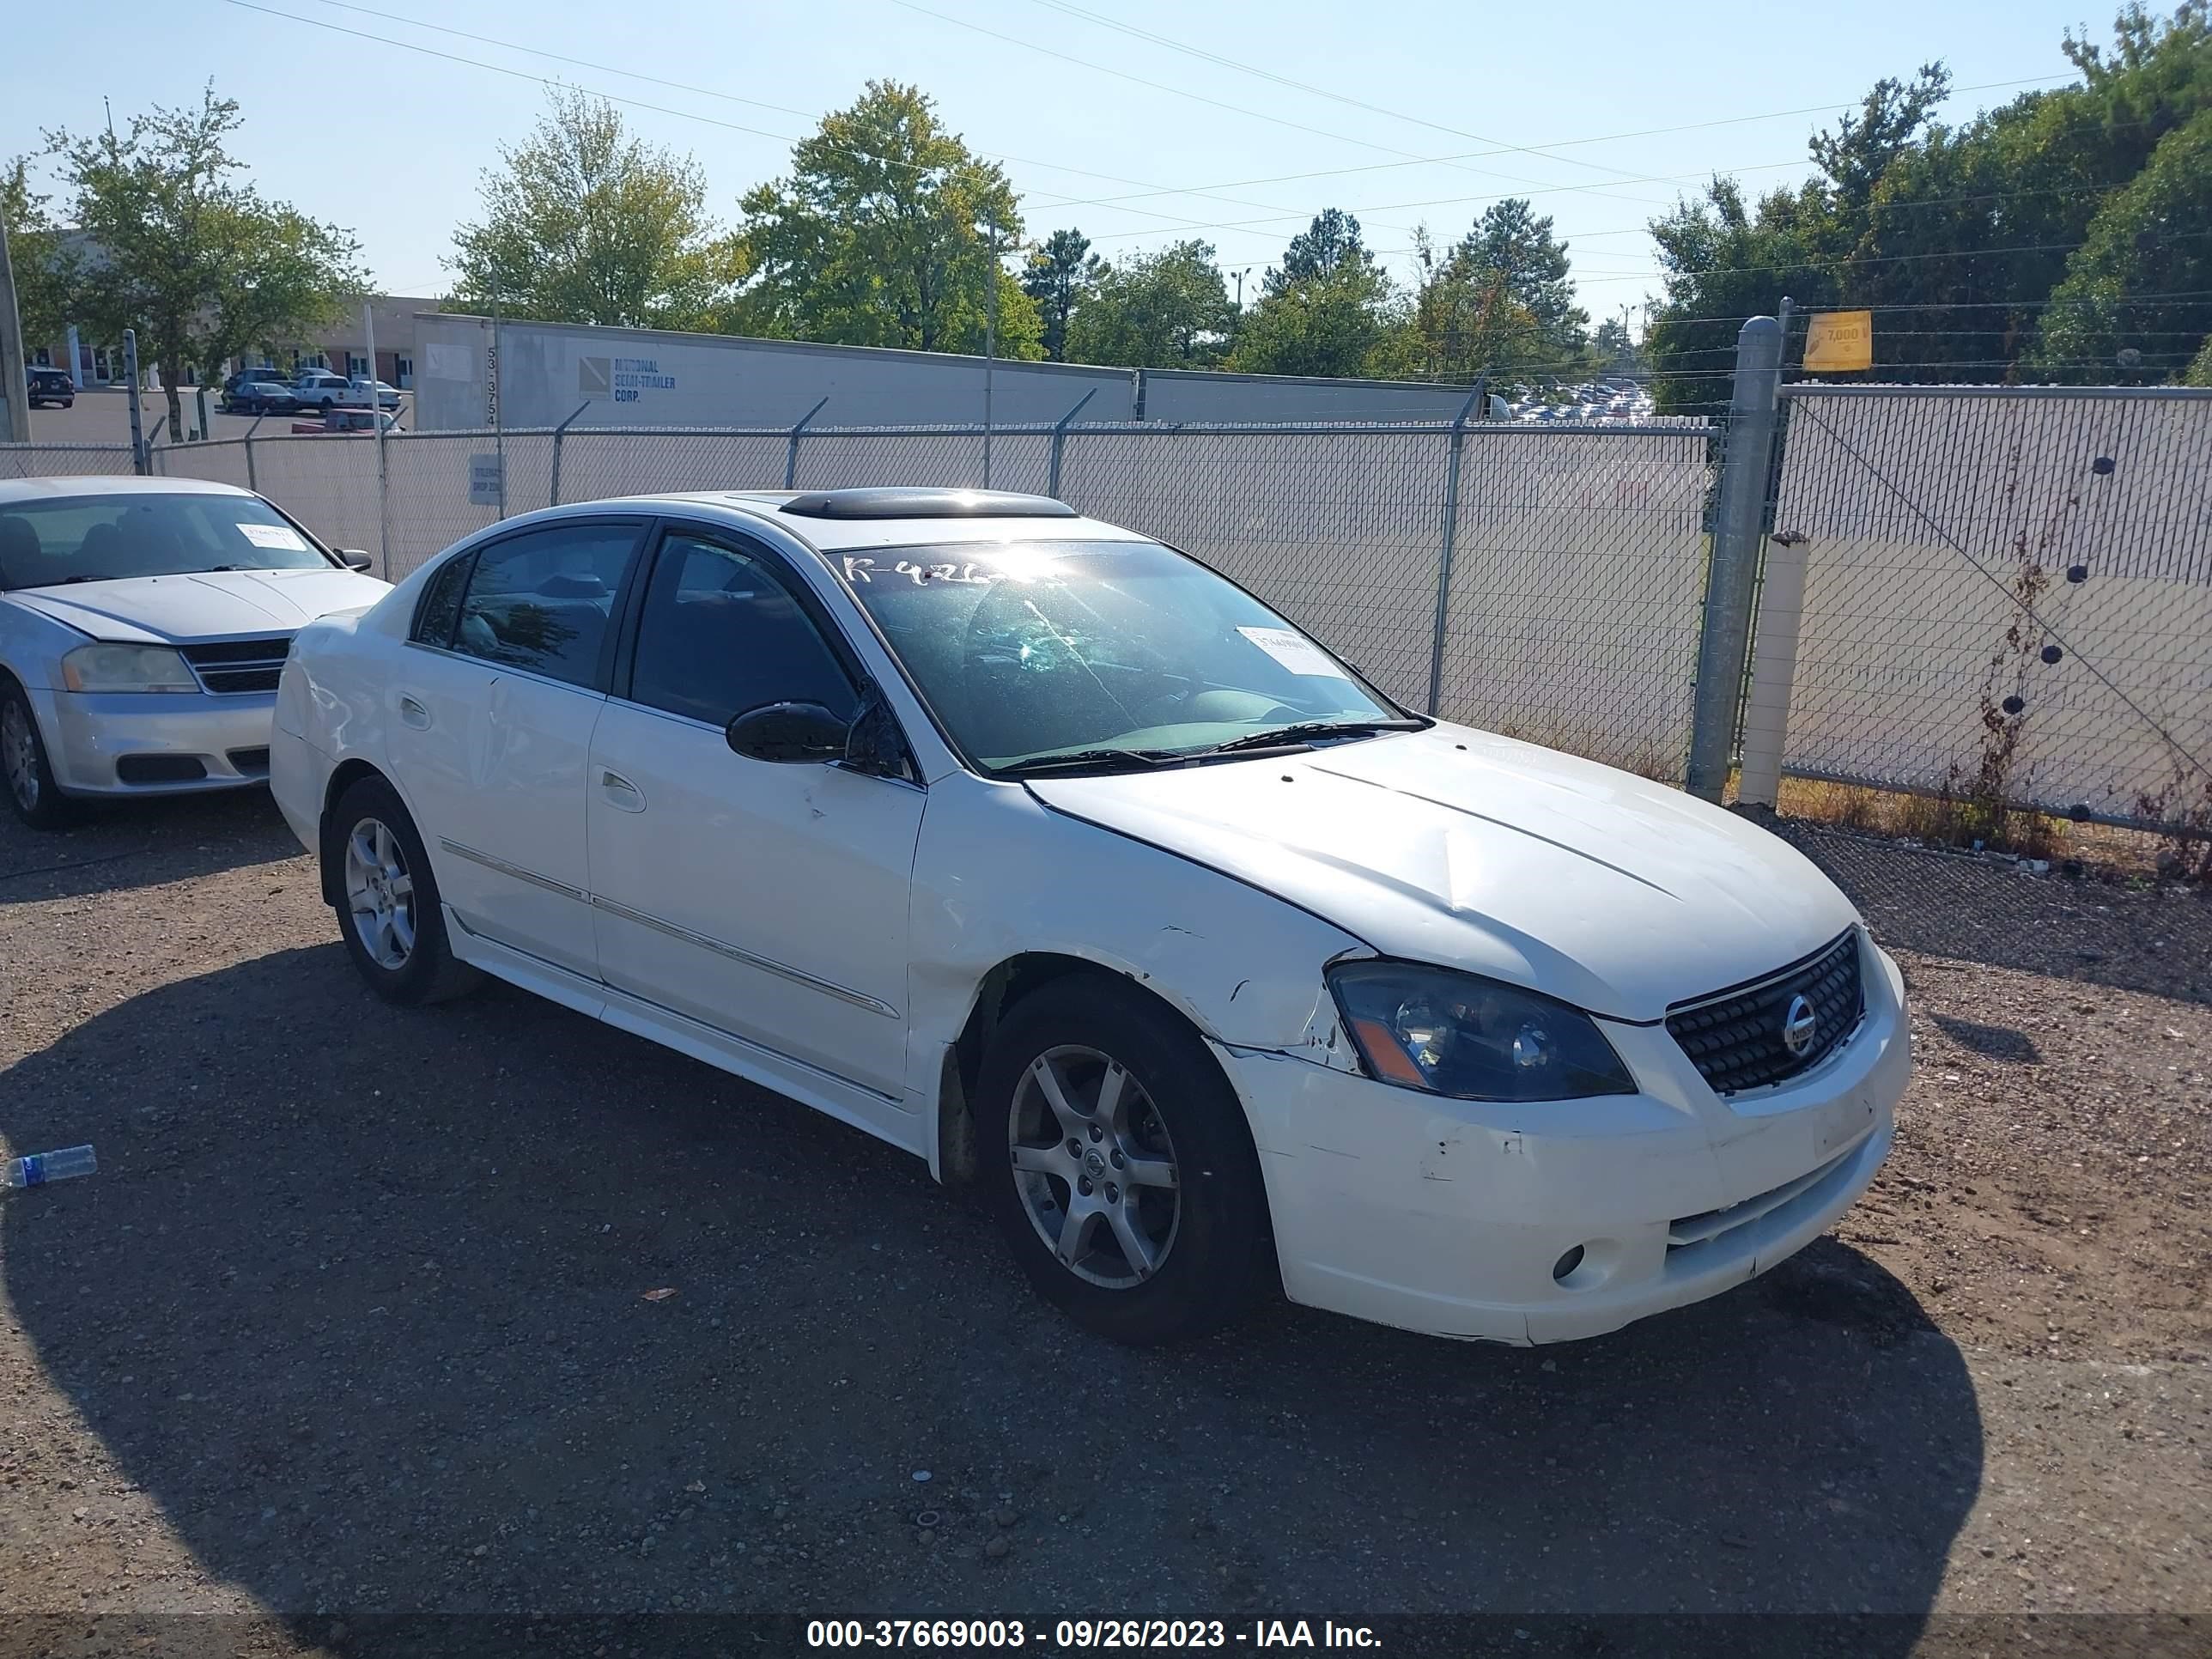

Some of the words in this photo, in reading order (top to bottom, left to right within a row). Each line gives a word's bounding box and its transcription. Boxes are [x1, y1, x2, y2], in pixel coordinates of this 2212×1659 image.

[1828, 329, 1858, 343] 7,000
[615, 374, 675, 389] SEMI-TRAILER
[615, 389, 641, 403] CORP.
